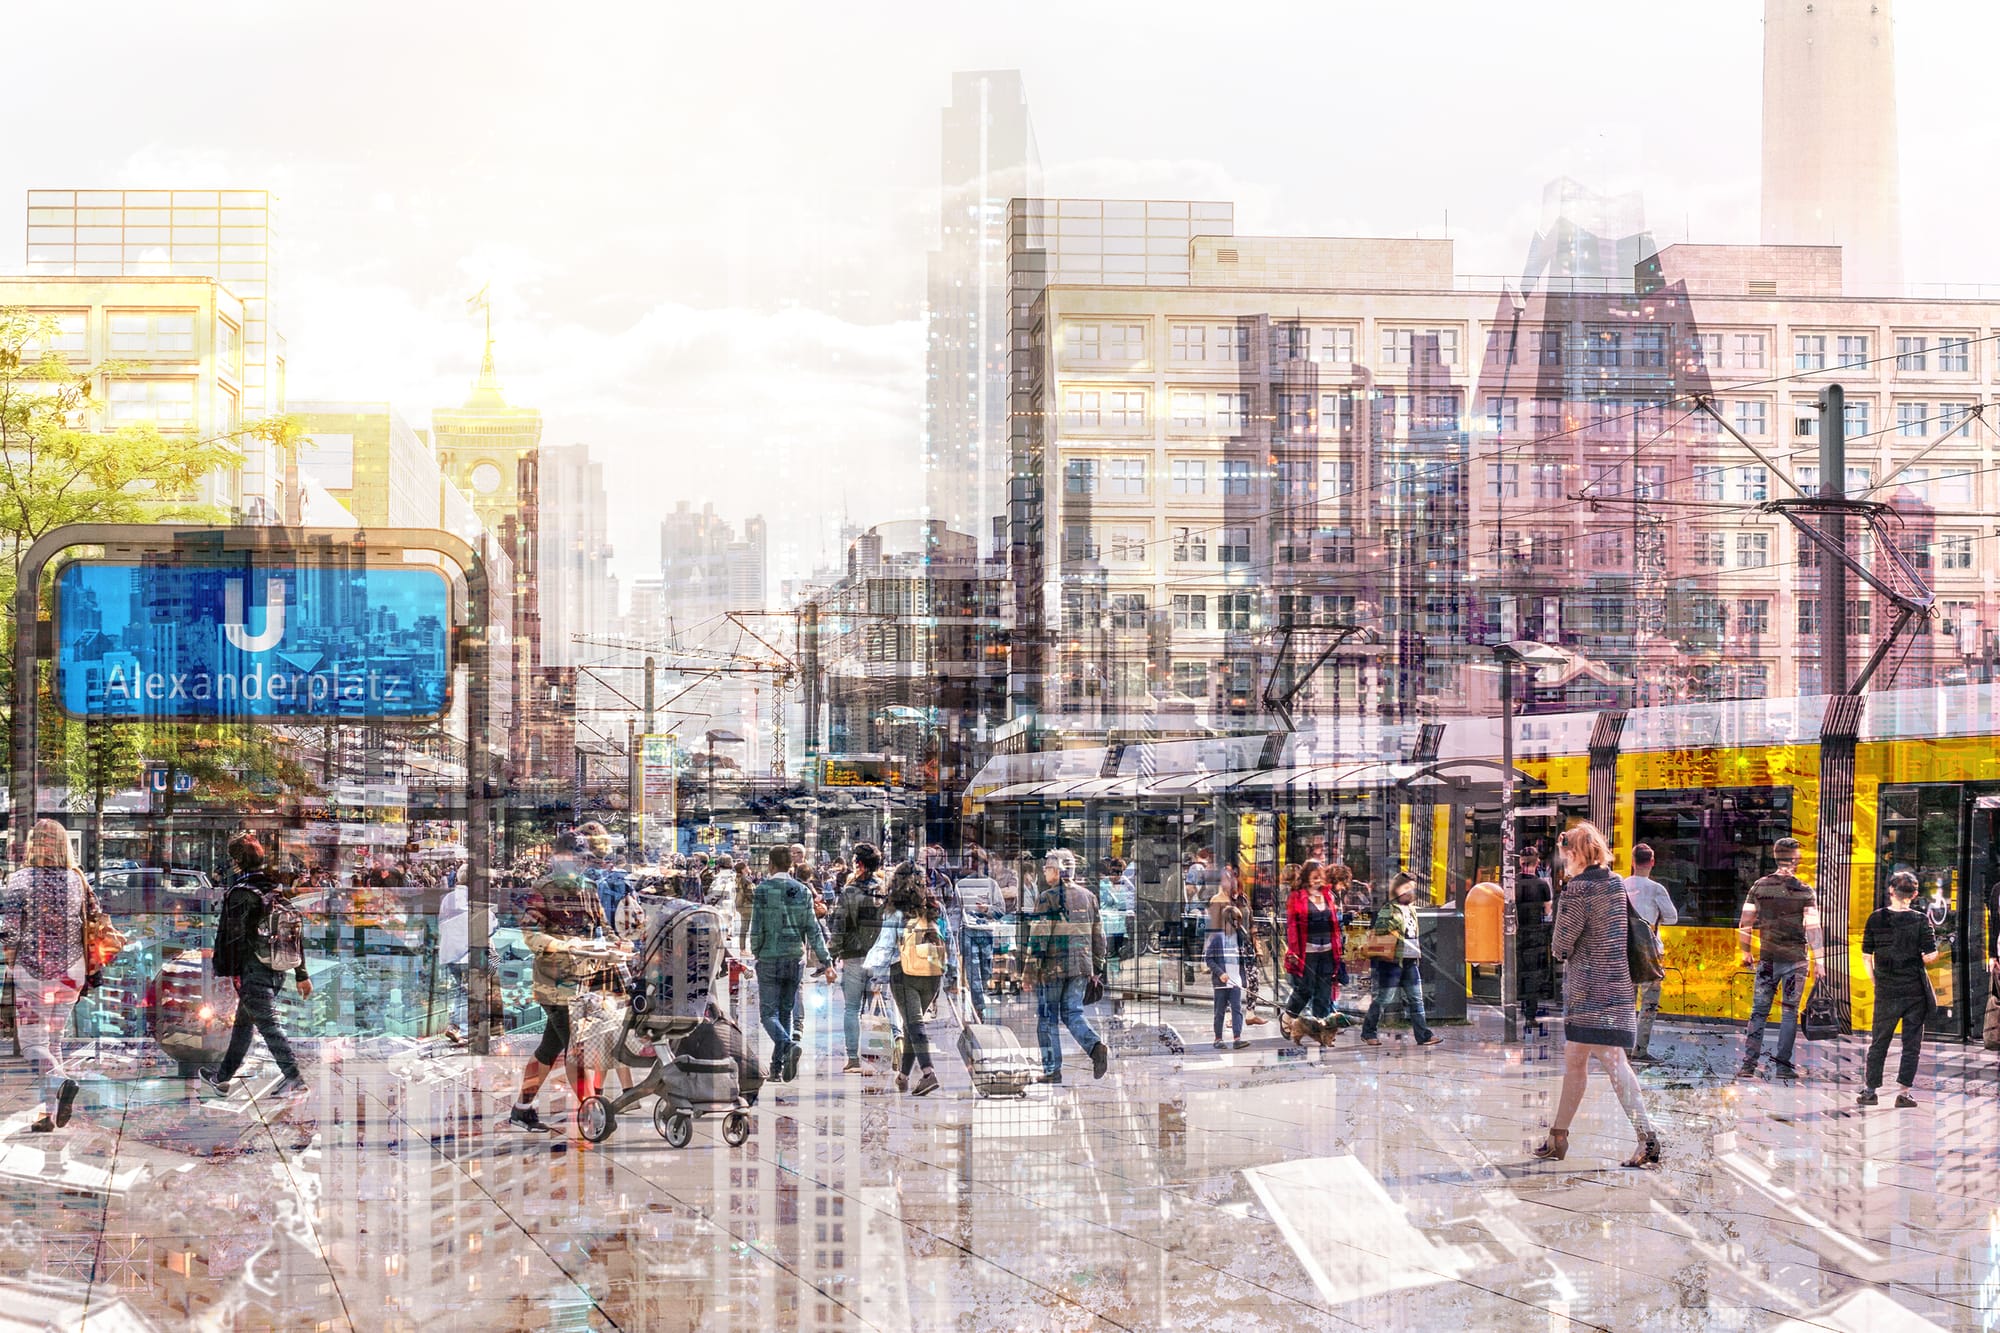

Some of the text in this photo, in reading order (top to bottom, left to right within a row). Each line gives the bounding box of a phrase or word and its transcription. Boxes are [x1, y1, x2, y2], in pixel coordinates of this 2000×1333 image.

[224, 577, 285, 652] U
[104, 661, 402, 712] Alexanderplatz
[154, 772, 168, 791] U
